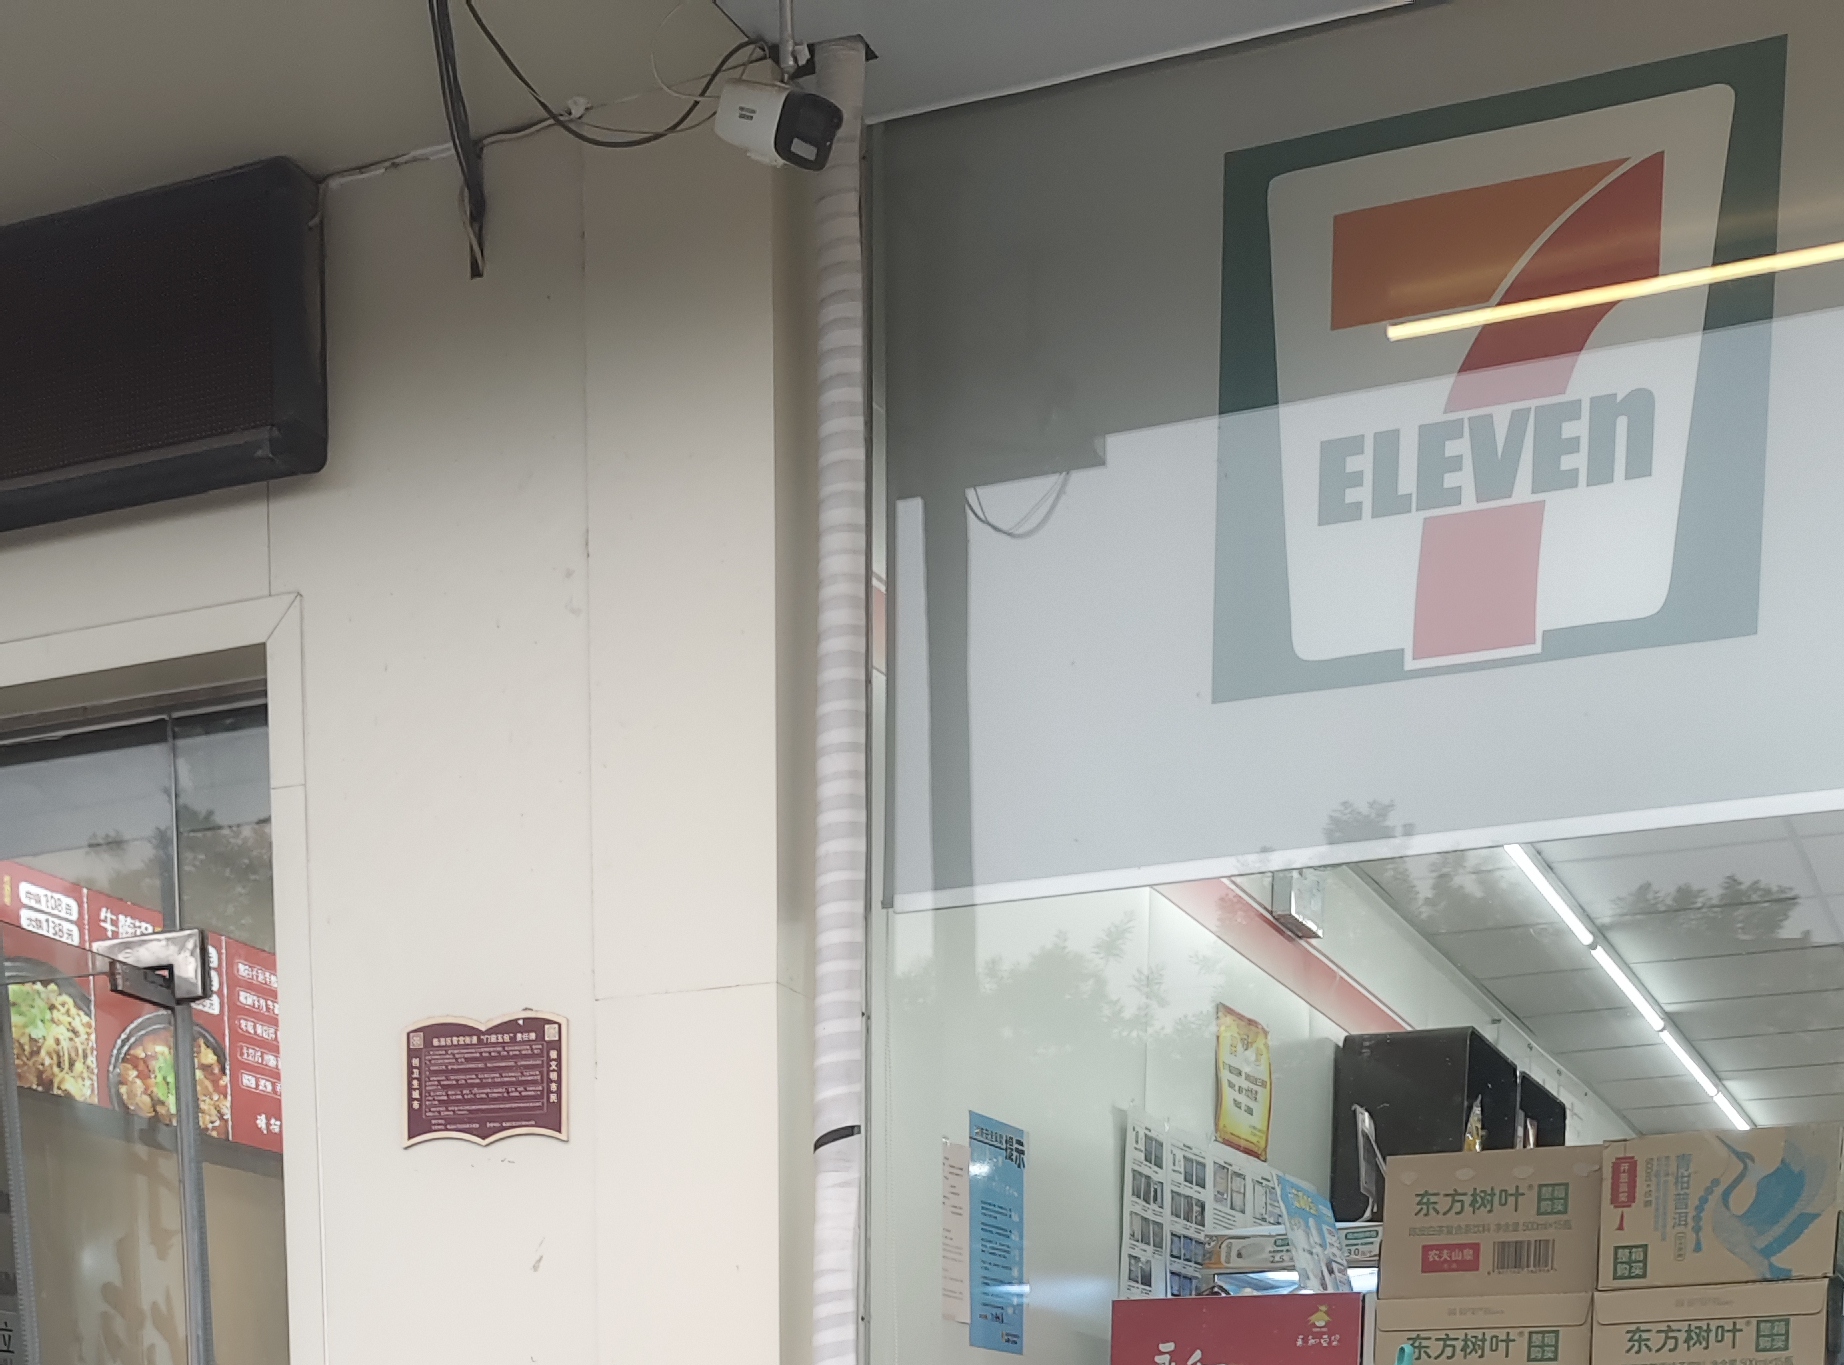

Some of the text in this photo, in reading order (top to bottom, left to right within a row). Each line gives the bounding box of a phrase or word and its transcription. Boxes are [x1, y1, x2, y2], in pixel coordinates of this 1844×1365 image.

[1331, 150, 1665, 660] 7
[1414, 1184, 1526, 1217] 东方树叶
[1428, 1249, 1474, 1262] 农夫山泉
[1406, 1331, 1516, 1361] 东方树叶
[1624, 1321, 1743, 1355] 东方树叶
